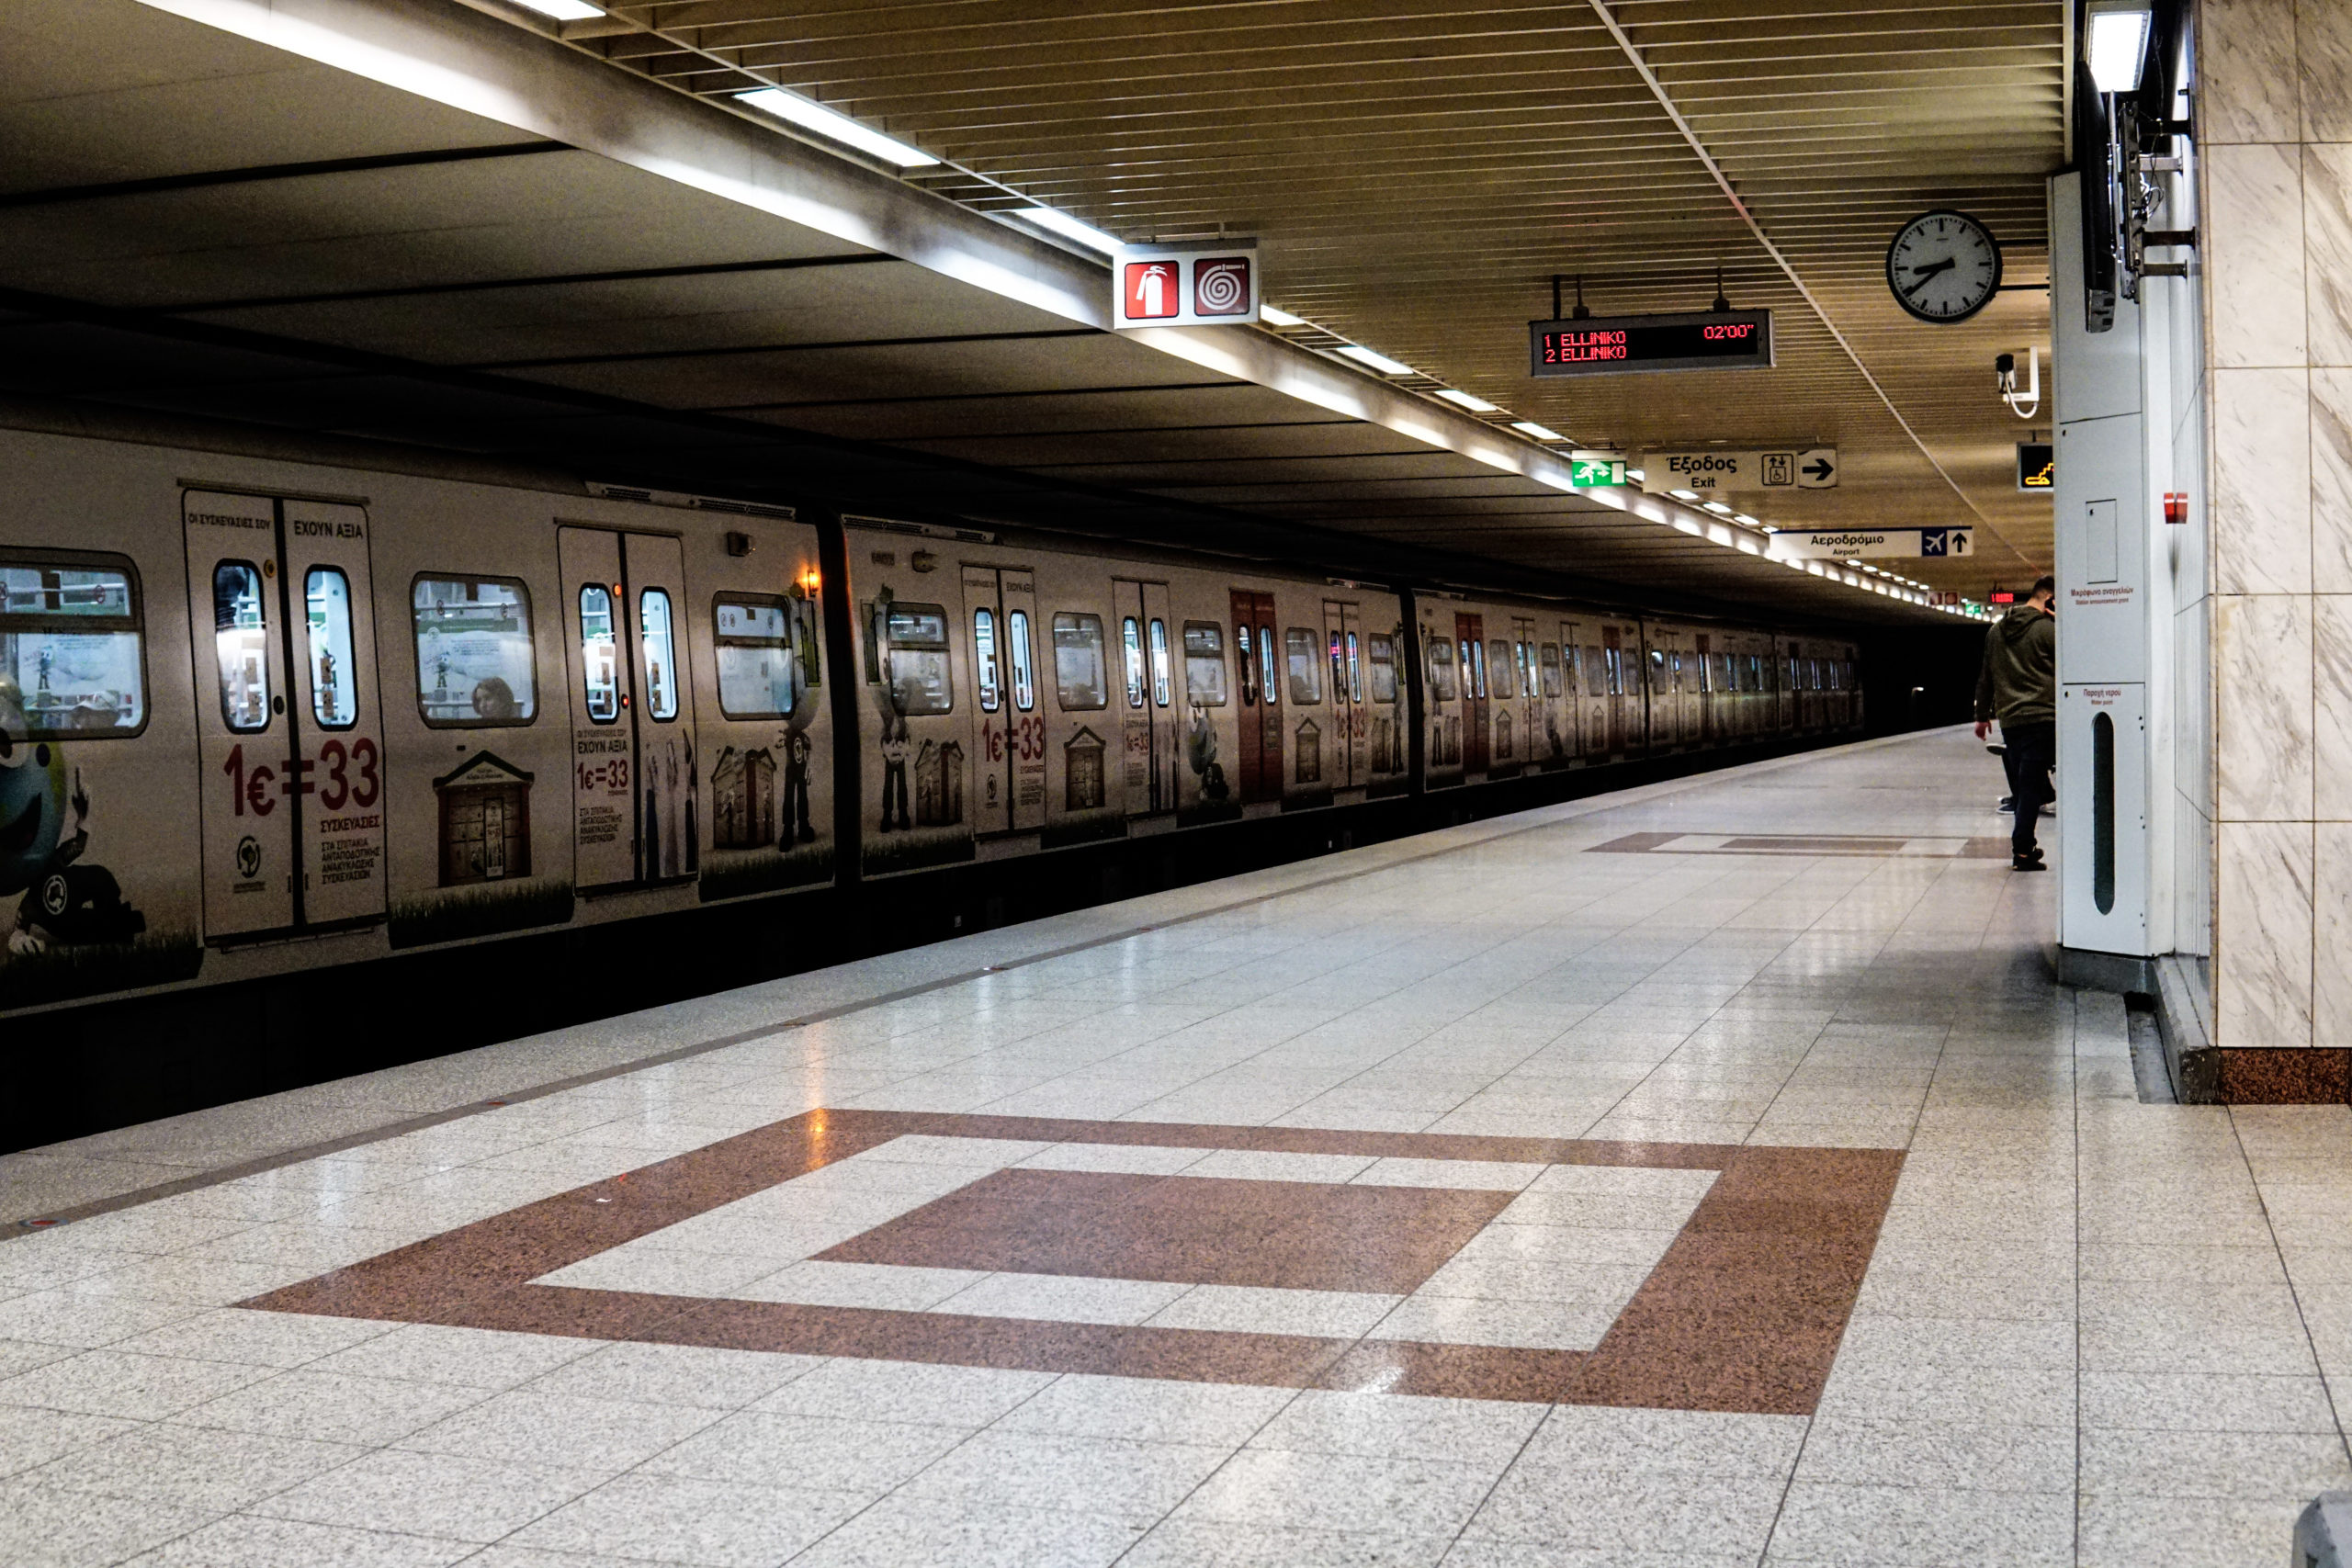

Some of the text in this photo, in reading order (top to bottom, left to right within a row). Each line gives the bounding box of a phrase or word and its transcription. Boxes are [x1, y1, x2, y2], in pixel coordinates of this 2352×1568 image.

[1544, 334, 1551, 348] 1
[1561, 331, 1626, 346] ELLINIKO
[1545, 345, 1627, 363] 2 ELLINIKO
[1666, 456, 1737, 475] Έξοδος
[1691, 477, 1716, 488] Exit
[294, 520, 364, 539] ΕΧΟΥΝ ΑΞΙΑ
[1810, 534, 1884, 547] Αεροδρόμιο
[1833, 548, 1860, 557] Airport
[2084, 688, 2104, 698] Παροχή
[578, 739, 628, 754] ΕΧΟΥΝ ΑΞΙΑ
[321, 815, 380, 834] ΣΥΣΚΕΥΑΣΙΕΣ
